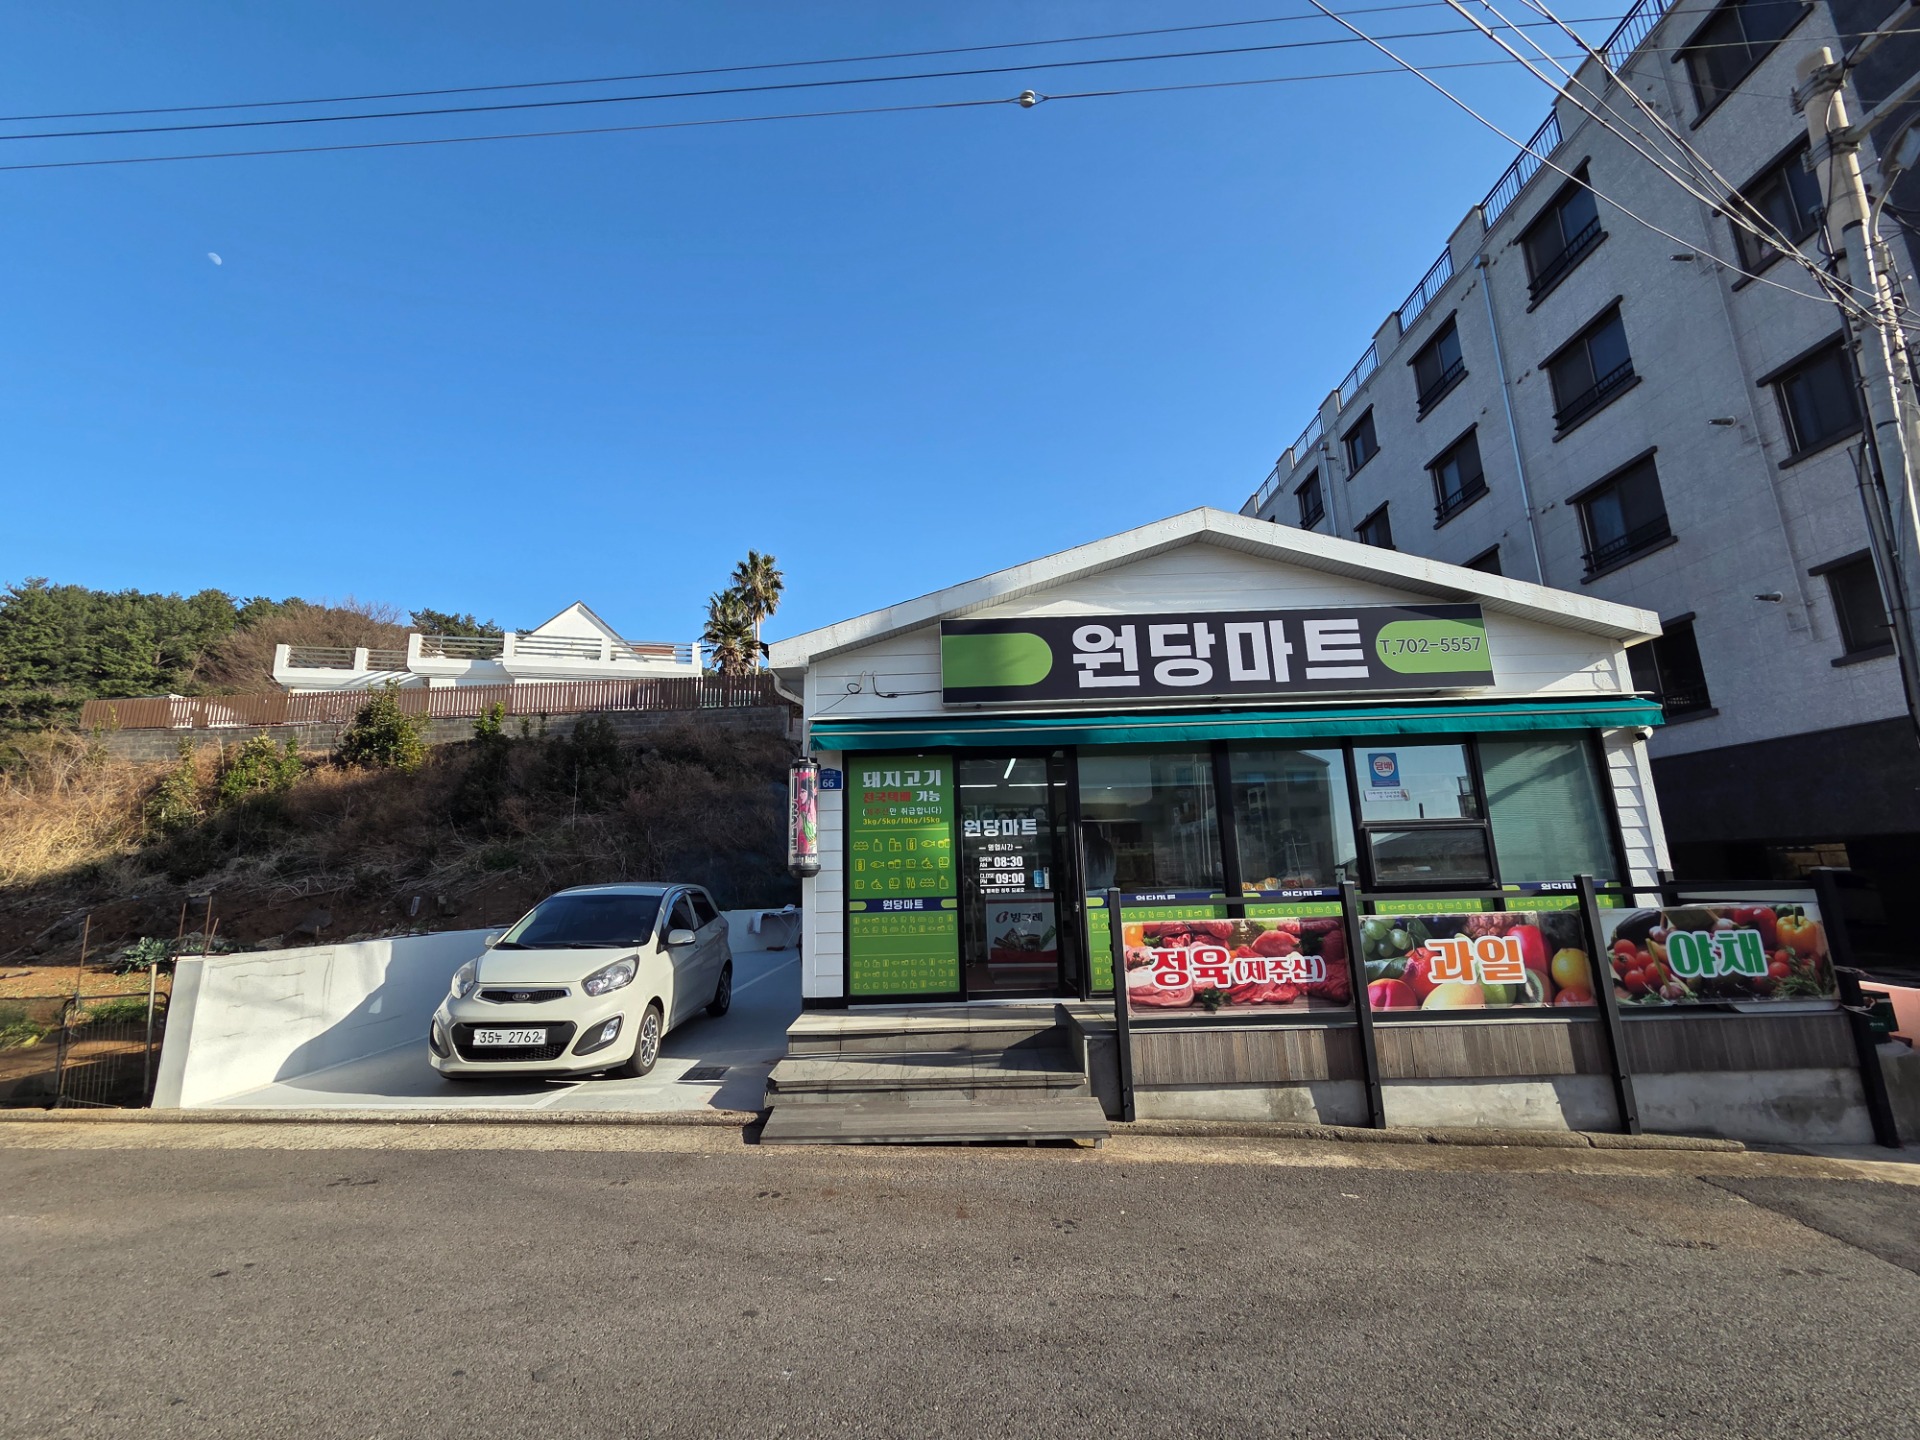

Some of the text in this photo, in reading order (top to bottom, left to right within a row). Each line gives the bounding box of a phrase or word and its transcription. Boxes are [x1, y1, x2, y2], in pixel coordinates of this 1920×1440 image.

[1071, 618, 1482, 688] 원당마트 T.702-5557
[1374, 761, 1394, 771] 담배
[822, 778, 835, 788] 66
[862, 769, 942, 788] 돼지고기
[916, 790, 941, 802] 가능
[862, 816, 941, 826] 3kg/5kg/10kg/15kg
[963, 818, 1038, 838] 원당마트
[987, 843, 1014, 852] 영업시간
[993, 855, 1023, 868] 08:30
[995, 872, 1025, 884] 09:00
[882, 898, 924, 910] 원당마트
[1010, 911, 1043, 923] 빙그레
[1426, 938, 1525, 982] 과일
[1667, 931, 1766, 977] 야채
[508, 1031, 539, 1043] 2762
